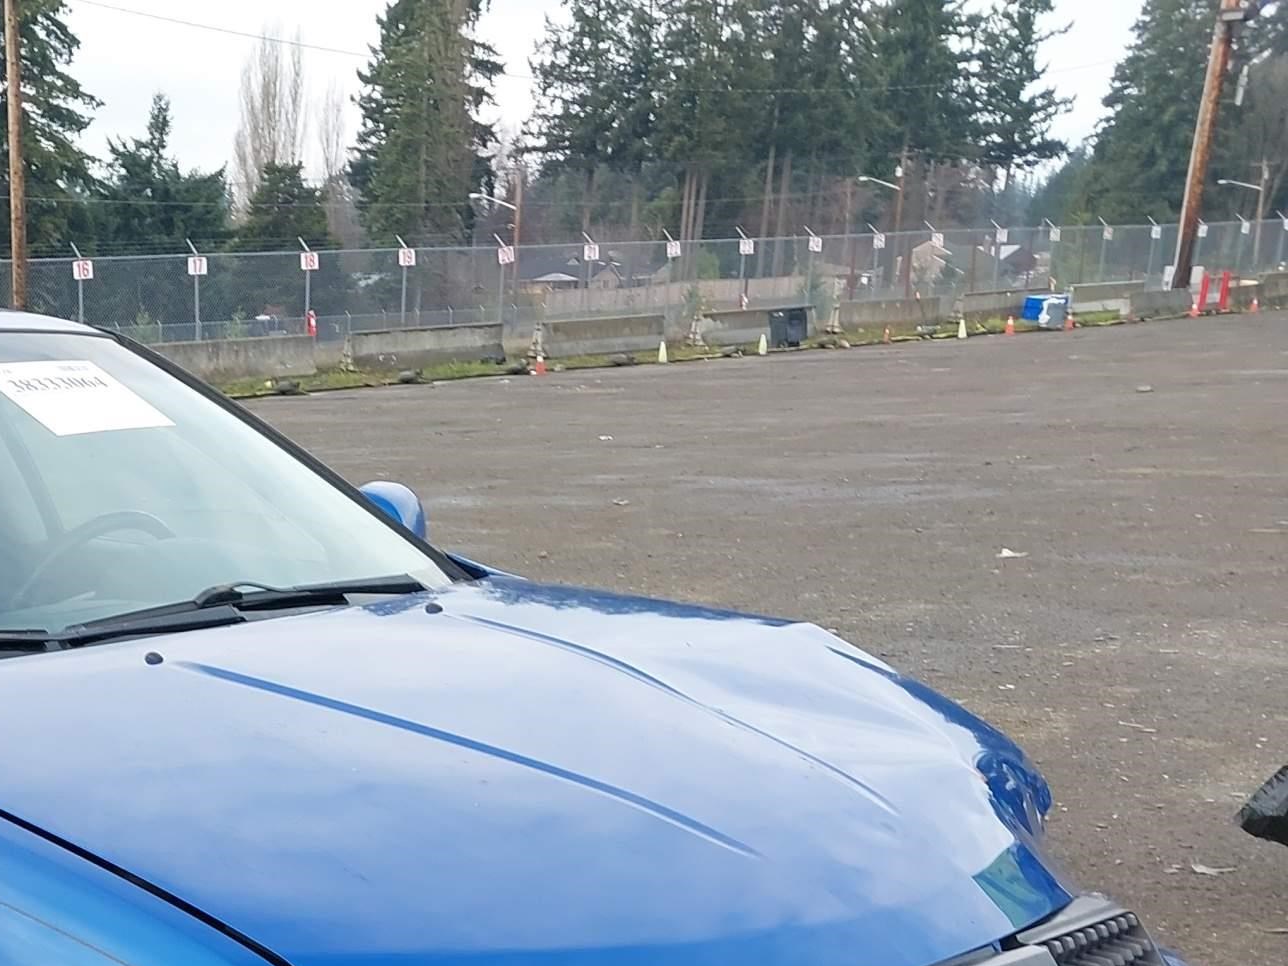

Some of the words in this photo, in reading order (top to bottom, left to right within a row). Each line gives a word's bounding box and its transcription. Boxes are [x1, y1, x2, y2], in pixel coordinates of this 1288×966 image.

[76, 260, 90, 277] 16
[192, 258, 203, 273] 17
[304, 254, 316, 268] 18
[7, 375, 109, 392] 38333064
